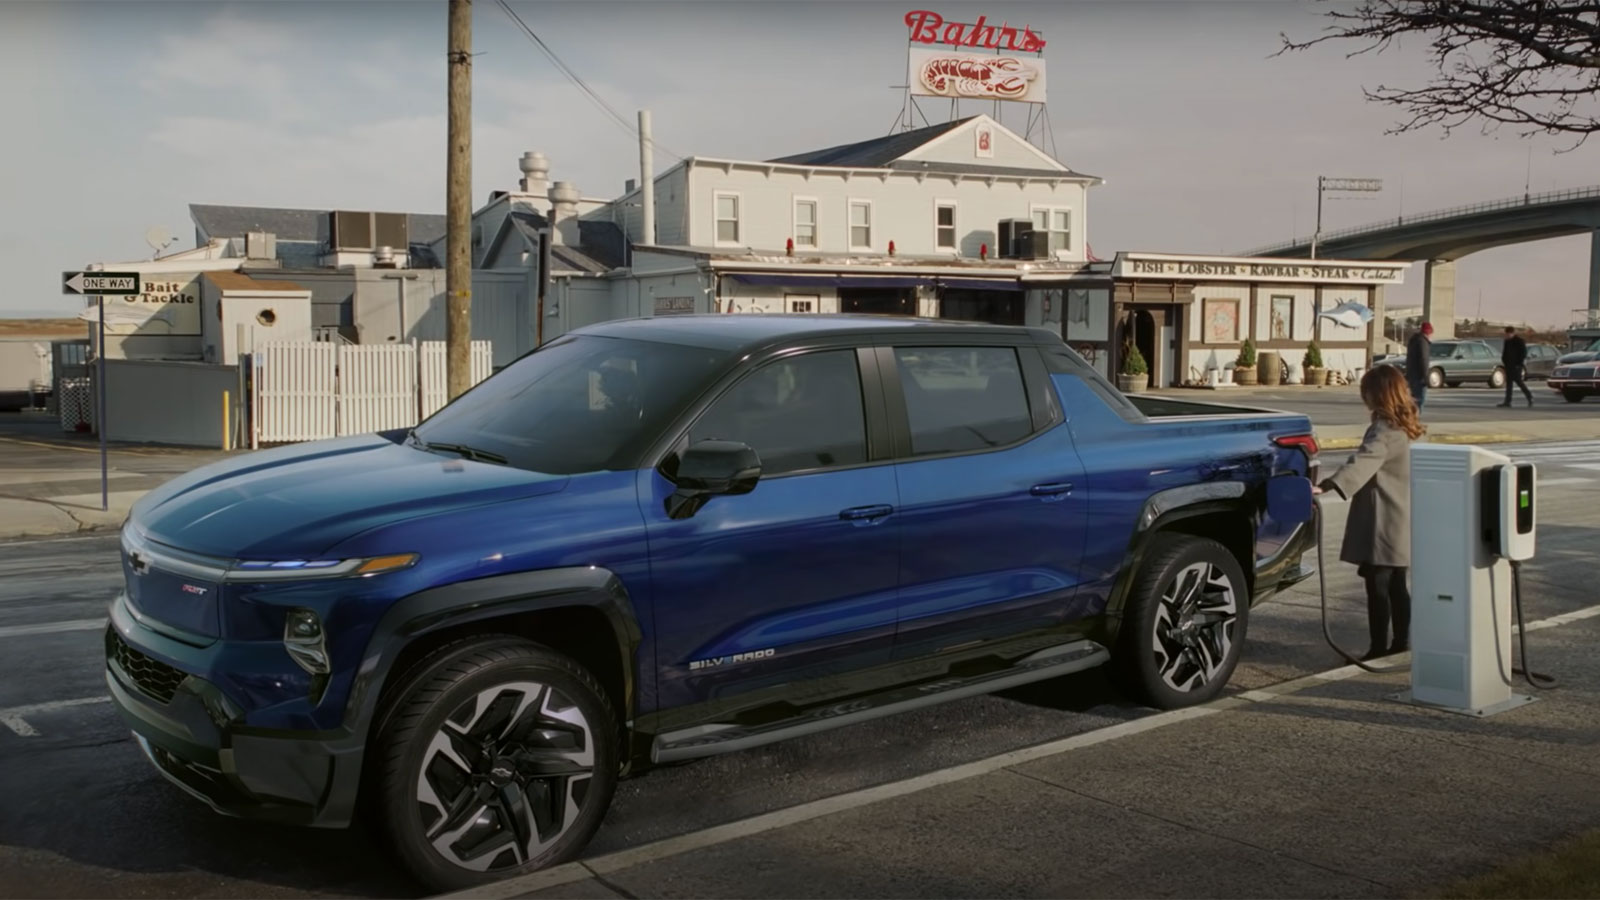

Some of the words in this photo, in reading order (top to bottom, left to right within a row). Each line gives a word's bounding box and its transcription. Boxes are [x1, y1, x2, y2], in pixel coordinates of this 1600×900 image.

[904, 10, 1046, 52] Bahrs
[1133, 260, 1164, 273] FISH
[1178, 261, 1236, 275] LOBSTER
[1250, 264, 1299, 278] RAWBAR
[1311, 265, 1350, 279] STEAK
[83, 278, 105, 288] ONE
[110, 278, 132, 288] WAY
[144, 282, 179, 292] Bait
[140, 293, 195, 304] Tackle
